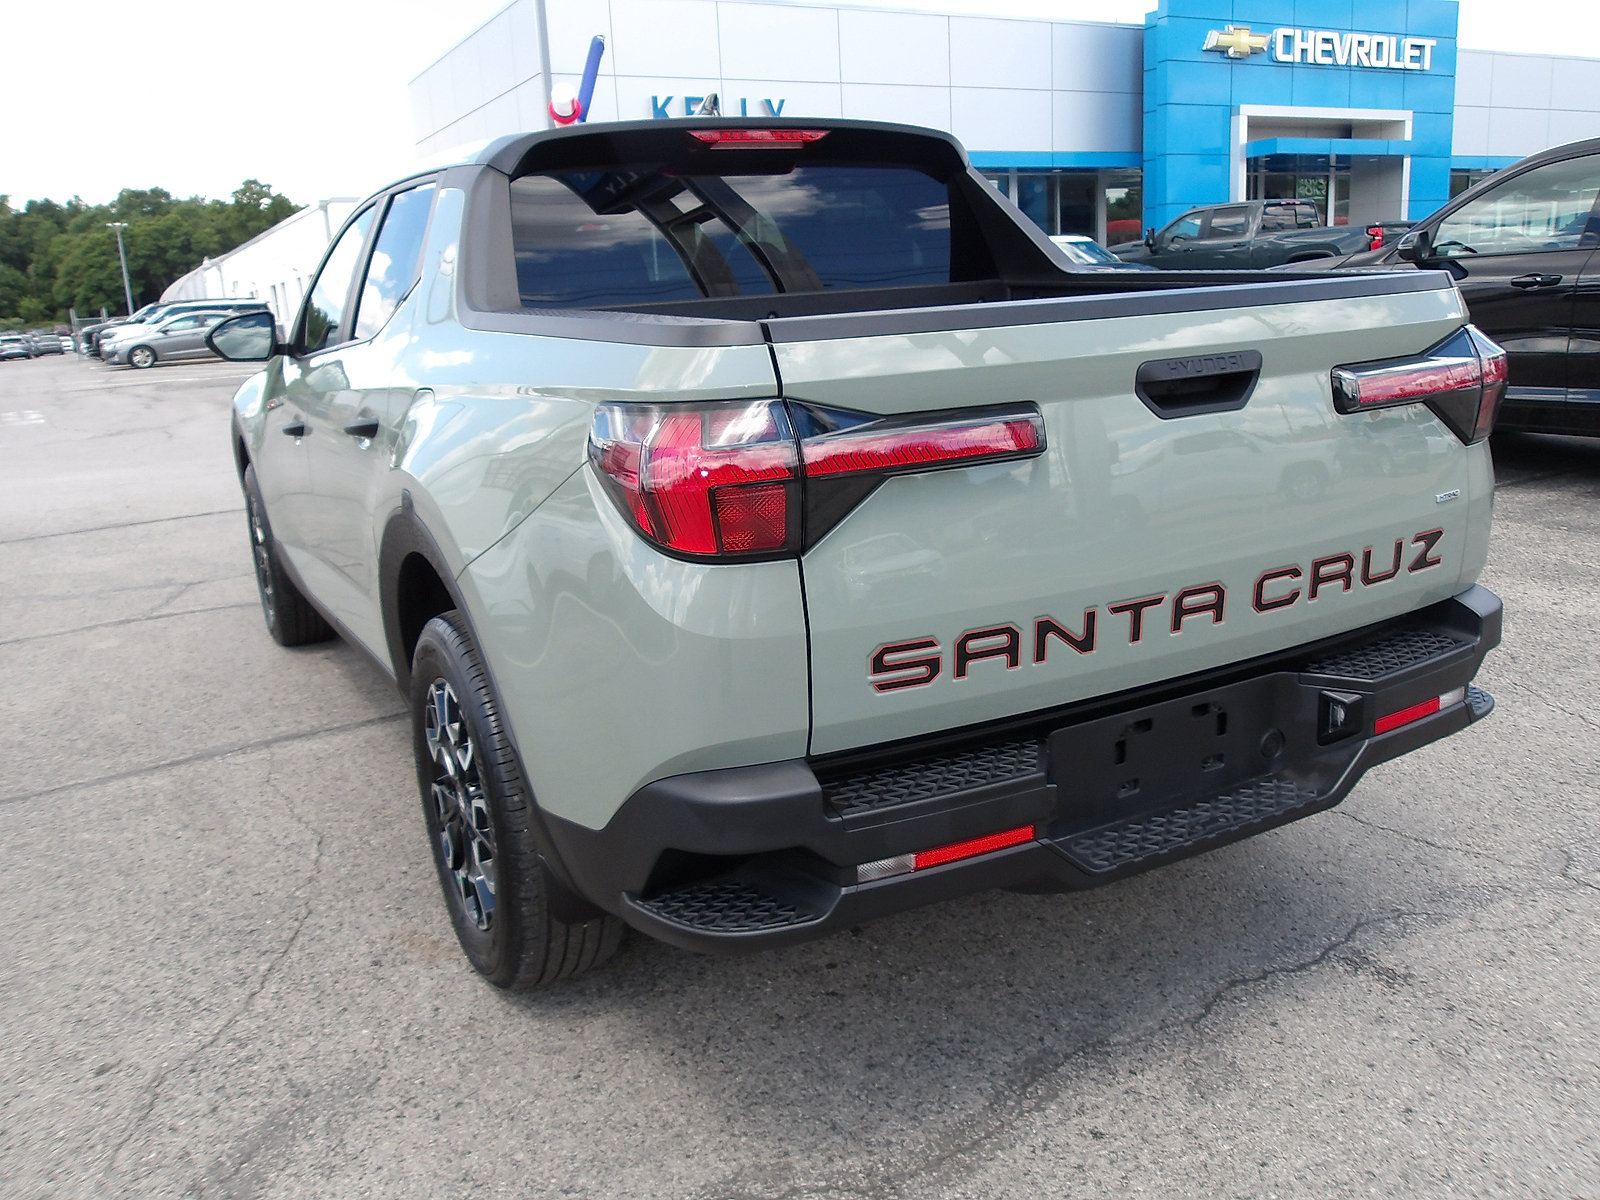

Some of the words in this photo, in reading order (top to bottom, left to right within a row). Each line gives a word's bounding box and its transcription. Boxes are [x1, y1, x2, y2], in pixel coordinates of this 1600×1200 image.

[1273, 27, 1436, 71] CHEVROLET
[1166, 354, 1246, 374] HYUNDAI
[868, 581, 1227, 694] SANTA
[1252, 528, 1444, 615] CRUZ
